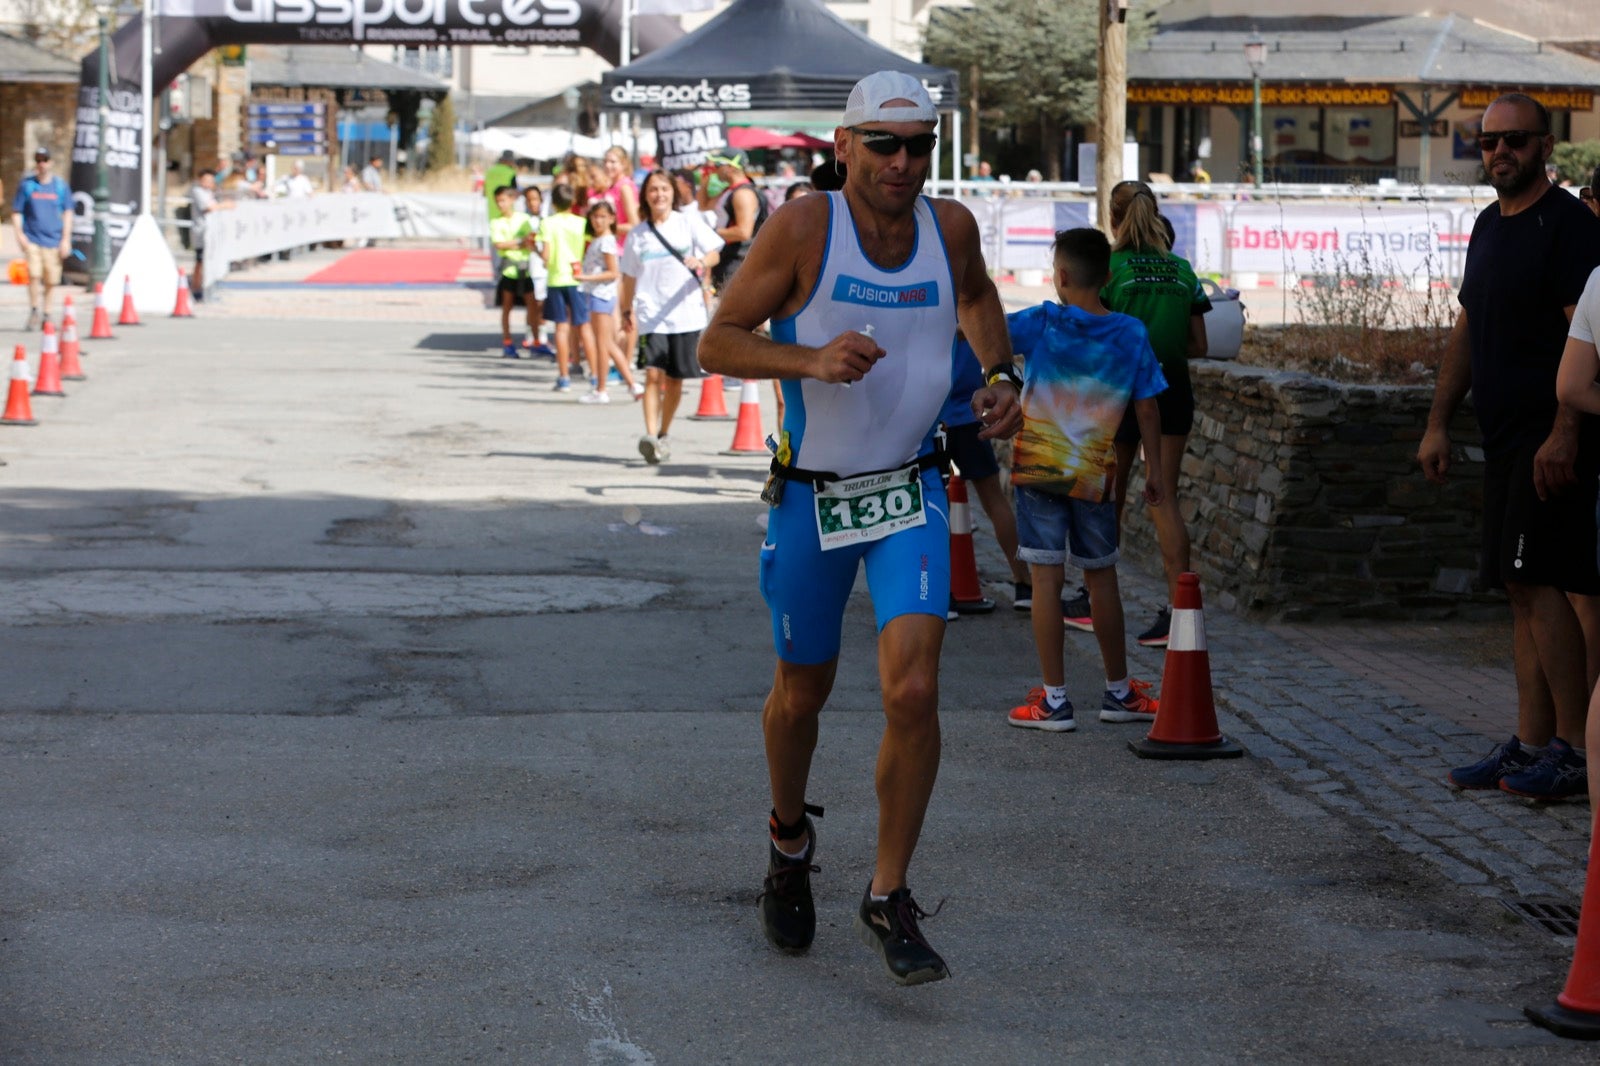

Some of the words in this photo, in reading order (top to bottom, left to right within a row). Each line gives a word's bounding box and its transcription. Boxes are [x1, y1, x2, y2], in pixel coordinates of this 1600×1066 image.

[366, 28, 438, 41] RUNNING
[448, 29, 493, 41] TRAIL
[504, 29, 581, 42] OUTDOOR
[656, 110, 724, 132] RUNNING
[659, 125, 728, 155] TRAIL
[72, 147, 139, 170] OUTOOR
[831, 488, 912, 528] 130
